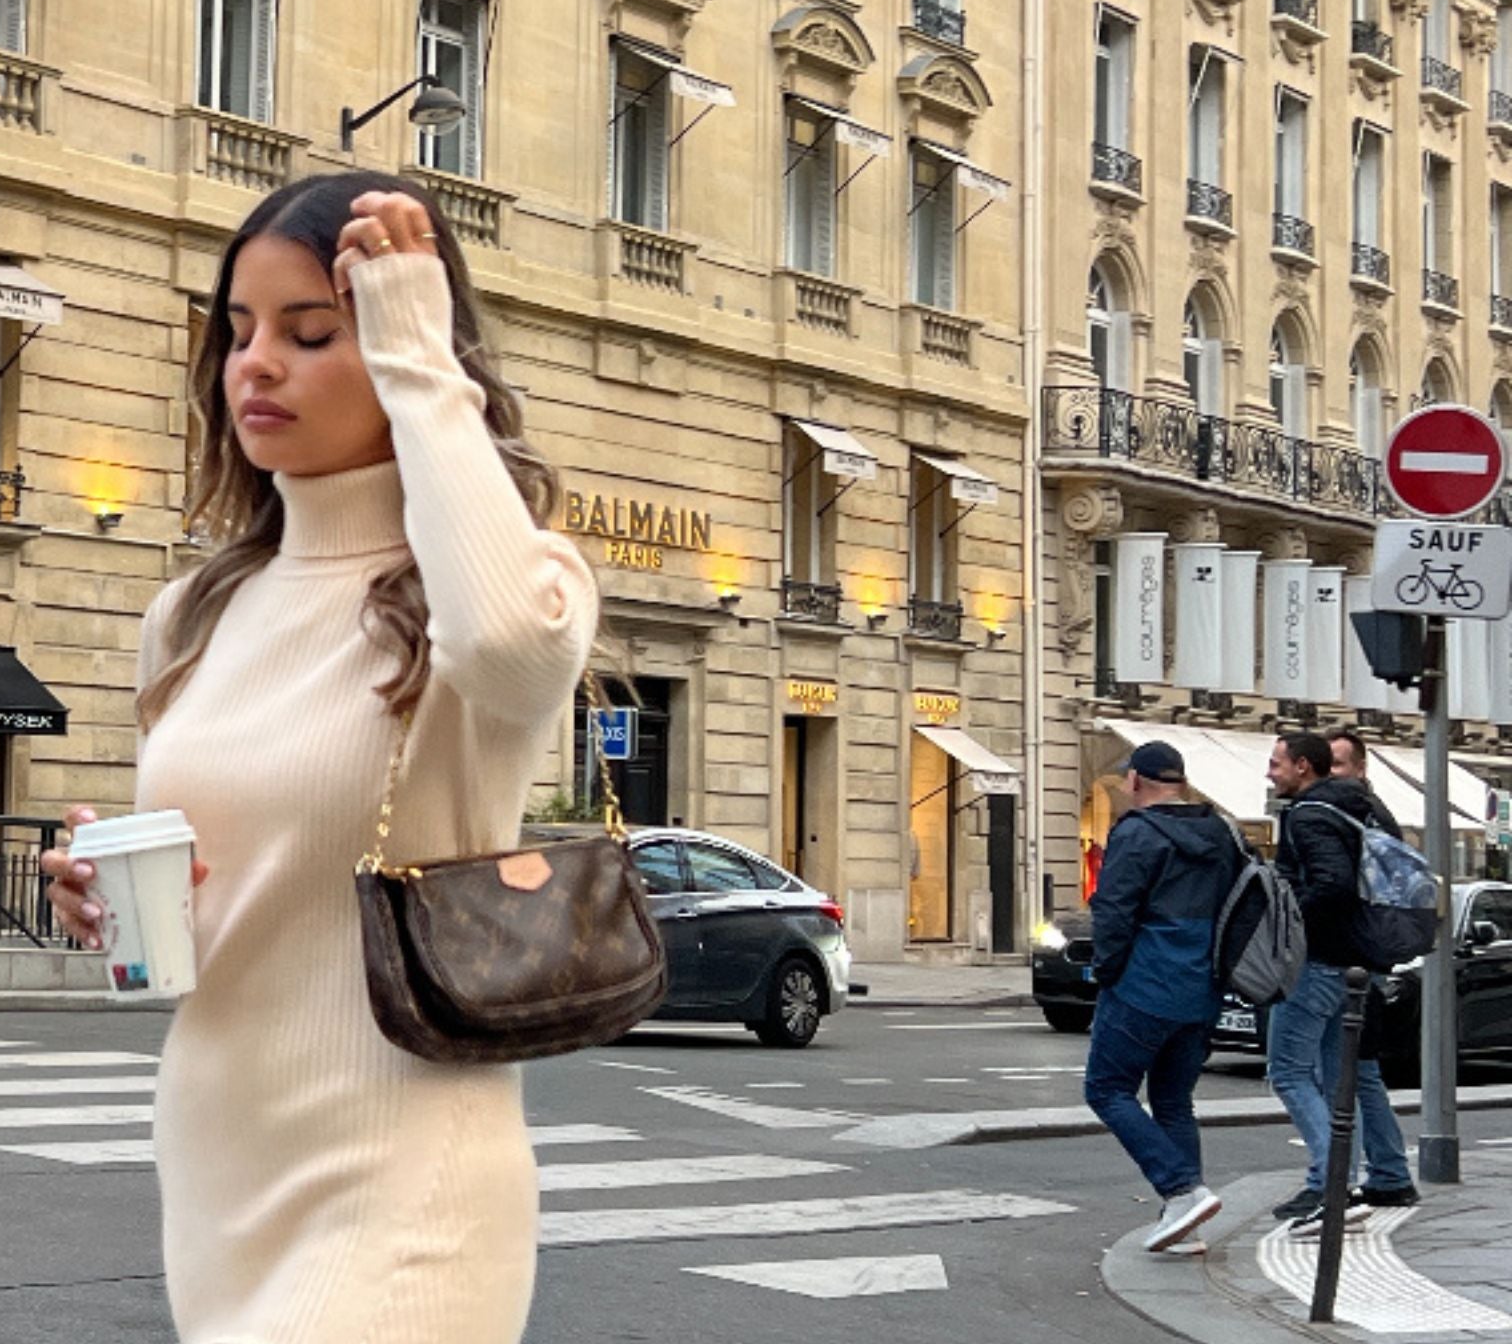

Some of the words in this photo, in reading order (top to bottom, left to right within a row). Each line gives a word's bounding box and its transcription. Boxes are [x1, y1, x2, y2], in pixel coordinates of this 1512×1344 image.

[566, 490, 711, 549] BALMAIN
[1408, 528, 1484, 553] SAUF
[606, 541, 663, 569] PARIS
